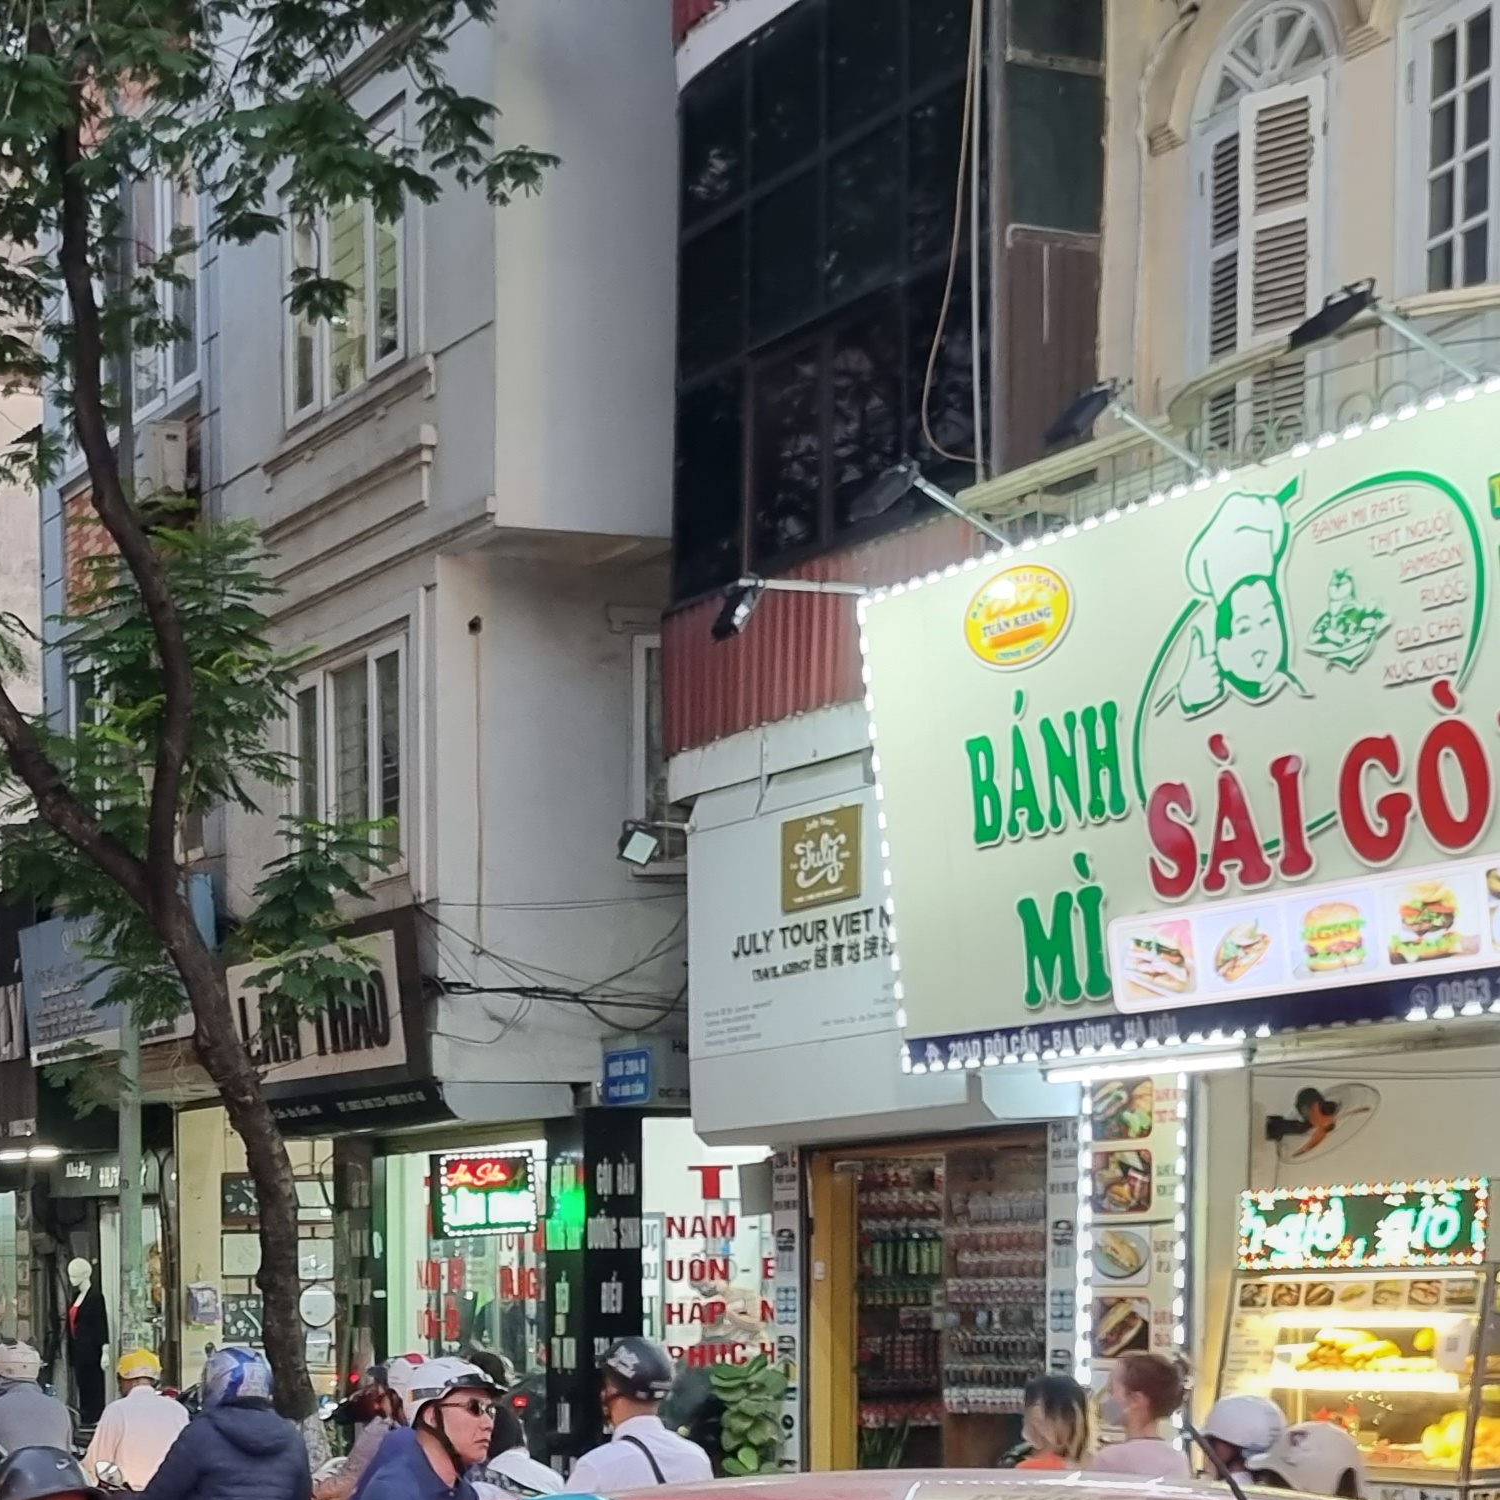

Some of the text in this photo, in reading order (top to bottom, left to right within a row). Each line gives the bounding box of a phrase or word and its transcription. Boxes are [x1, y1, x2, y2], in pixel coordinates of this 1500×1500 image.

[965, 689, 1127, 846] BÁNH
[1147, 679, 1500, 902] SÀI GÒ
[732, 928, 775, 960] JULY
[778, 918, 829, 950] TOUR
[832, 907, 875, 938] VIET
[1016, 851, 1112, 1007] MÌ
[665, 1215, 737, 1239] NAM
